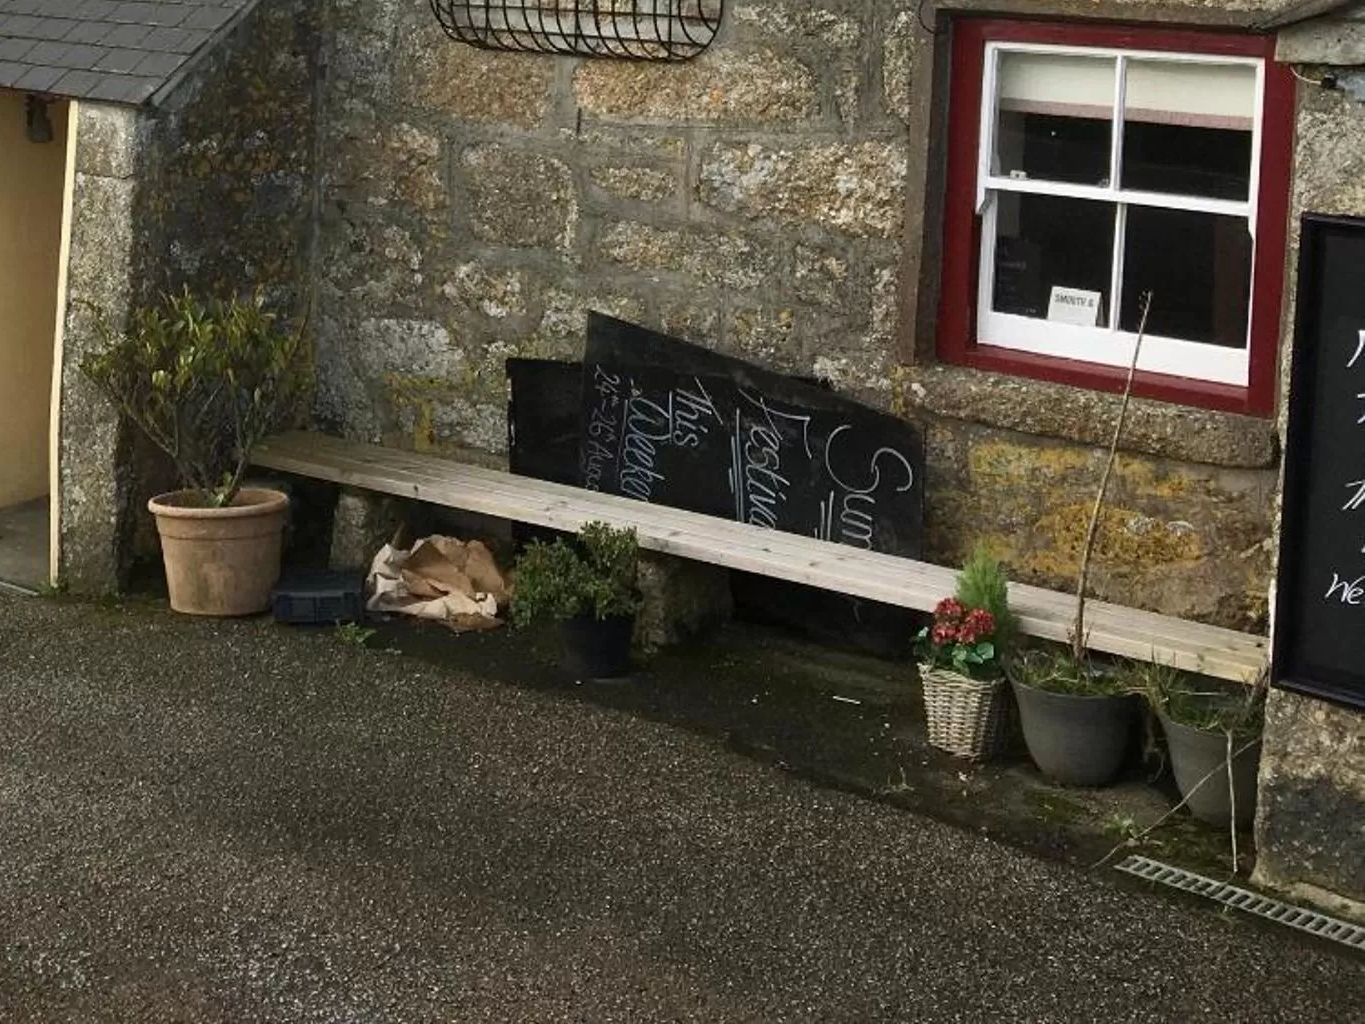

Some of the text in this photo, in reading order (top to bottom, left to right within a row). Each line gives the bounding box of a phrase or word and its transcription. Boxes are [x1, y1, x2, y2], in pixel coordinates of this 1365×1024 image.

[619, 395, 672, 503] Weeke
[672, 375, 724, 447] This
[737, 387, 812, 531] Festiva
[824, 423, 914, 550] Sum
